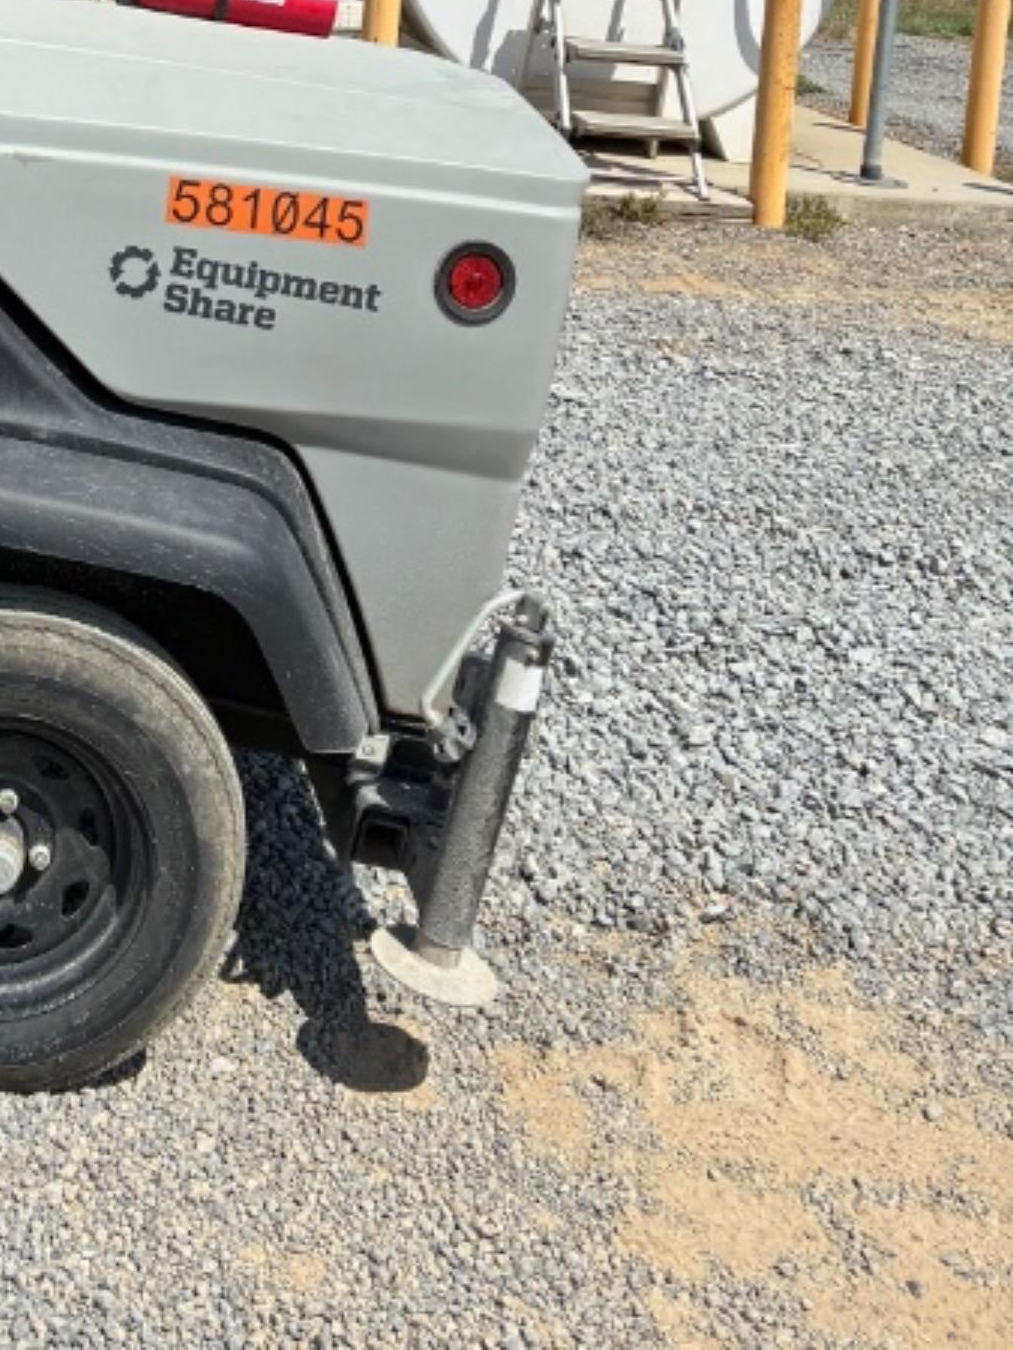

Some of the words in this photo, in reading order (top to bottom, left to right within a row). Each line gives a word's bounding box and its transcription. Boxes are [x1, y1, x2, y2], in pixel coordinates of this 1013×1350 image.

[170, 179, 366, 243] 581045
[163, 283, 277, 331] Share
[169, 246, 382, 312] Equipment
